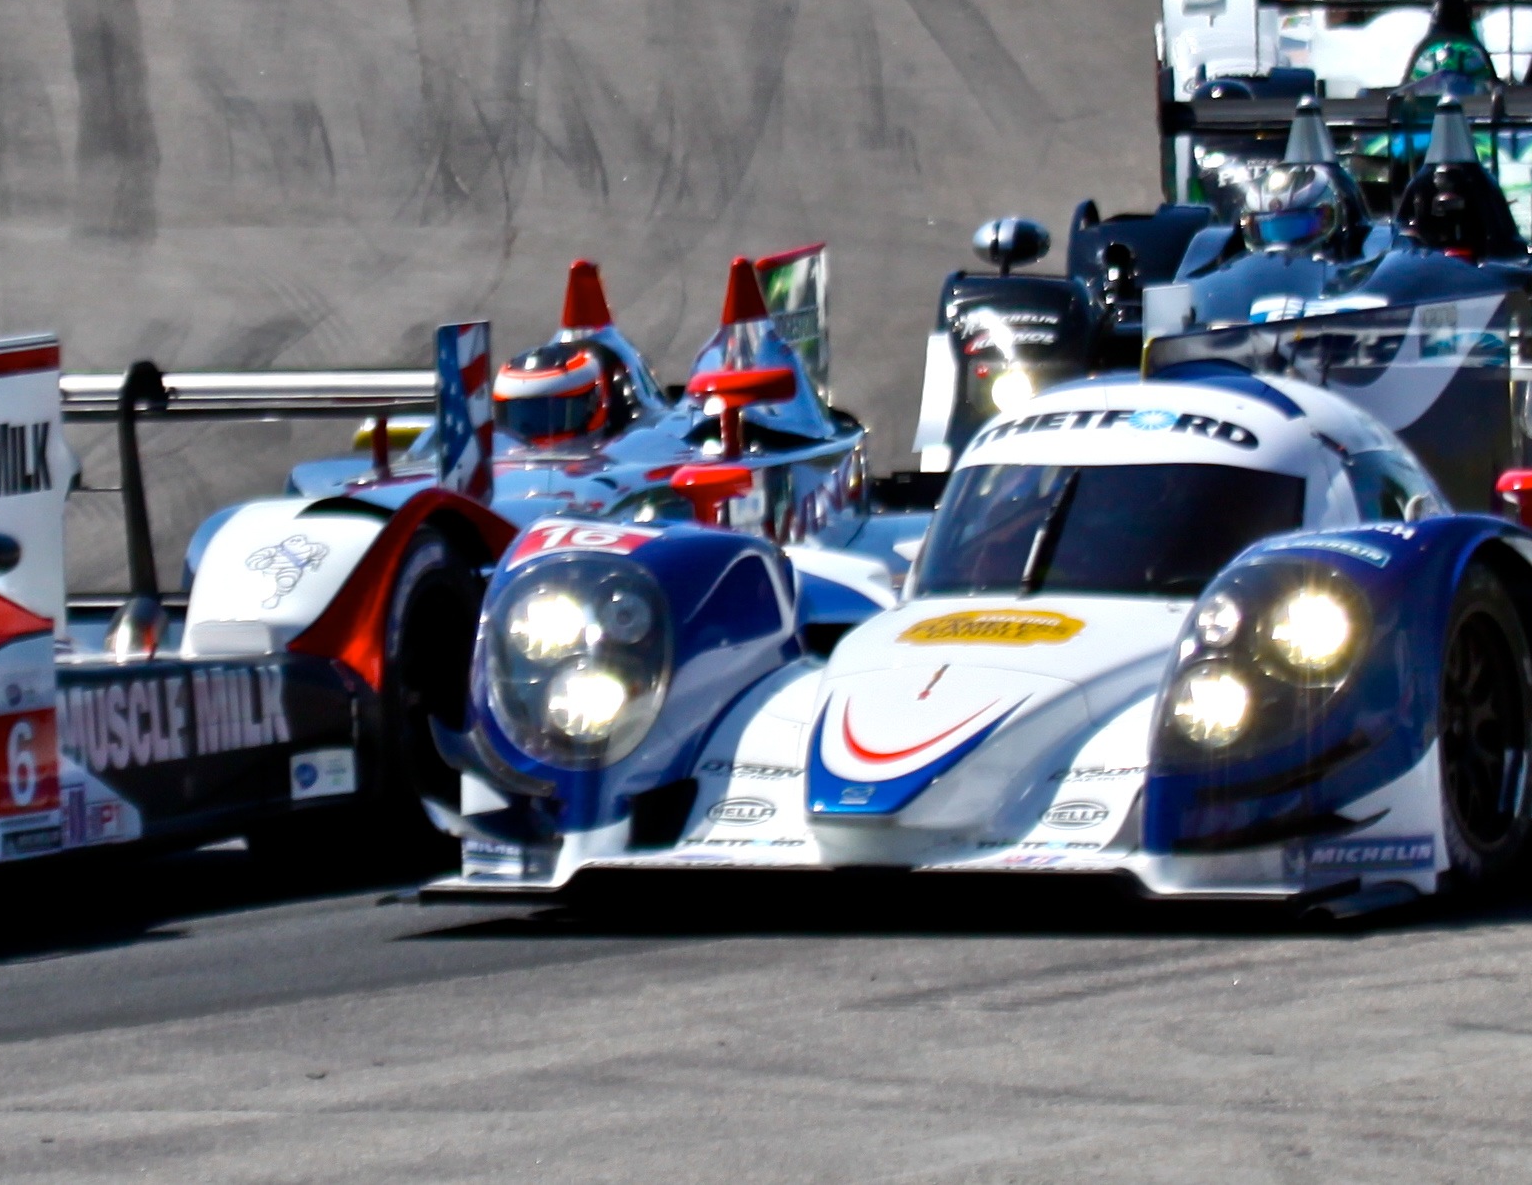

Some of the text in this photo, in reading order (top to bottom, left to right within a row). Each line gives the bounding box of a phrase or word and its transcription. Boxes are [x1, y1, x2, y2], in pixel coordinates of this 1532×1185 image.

[968, 408, 1259, 450] THETFORD
[542, 525, 624, 549] 16
[57, 664, 291, 772] MUSCLE MILK
[6, 721, 37, 807] 6
[714, 805, 774, 823] HELLA
[1046, 806, 1108, 825] HELLA
[1311, 844, 1435, 866] MICHELIN
